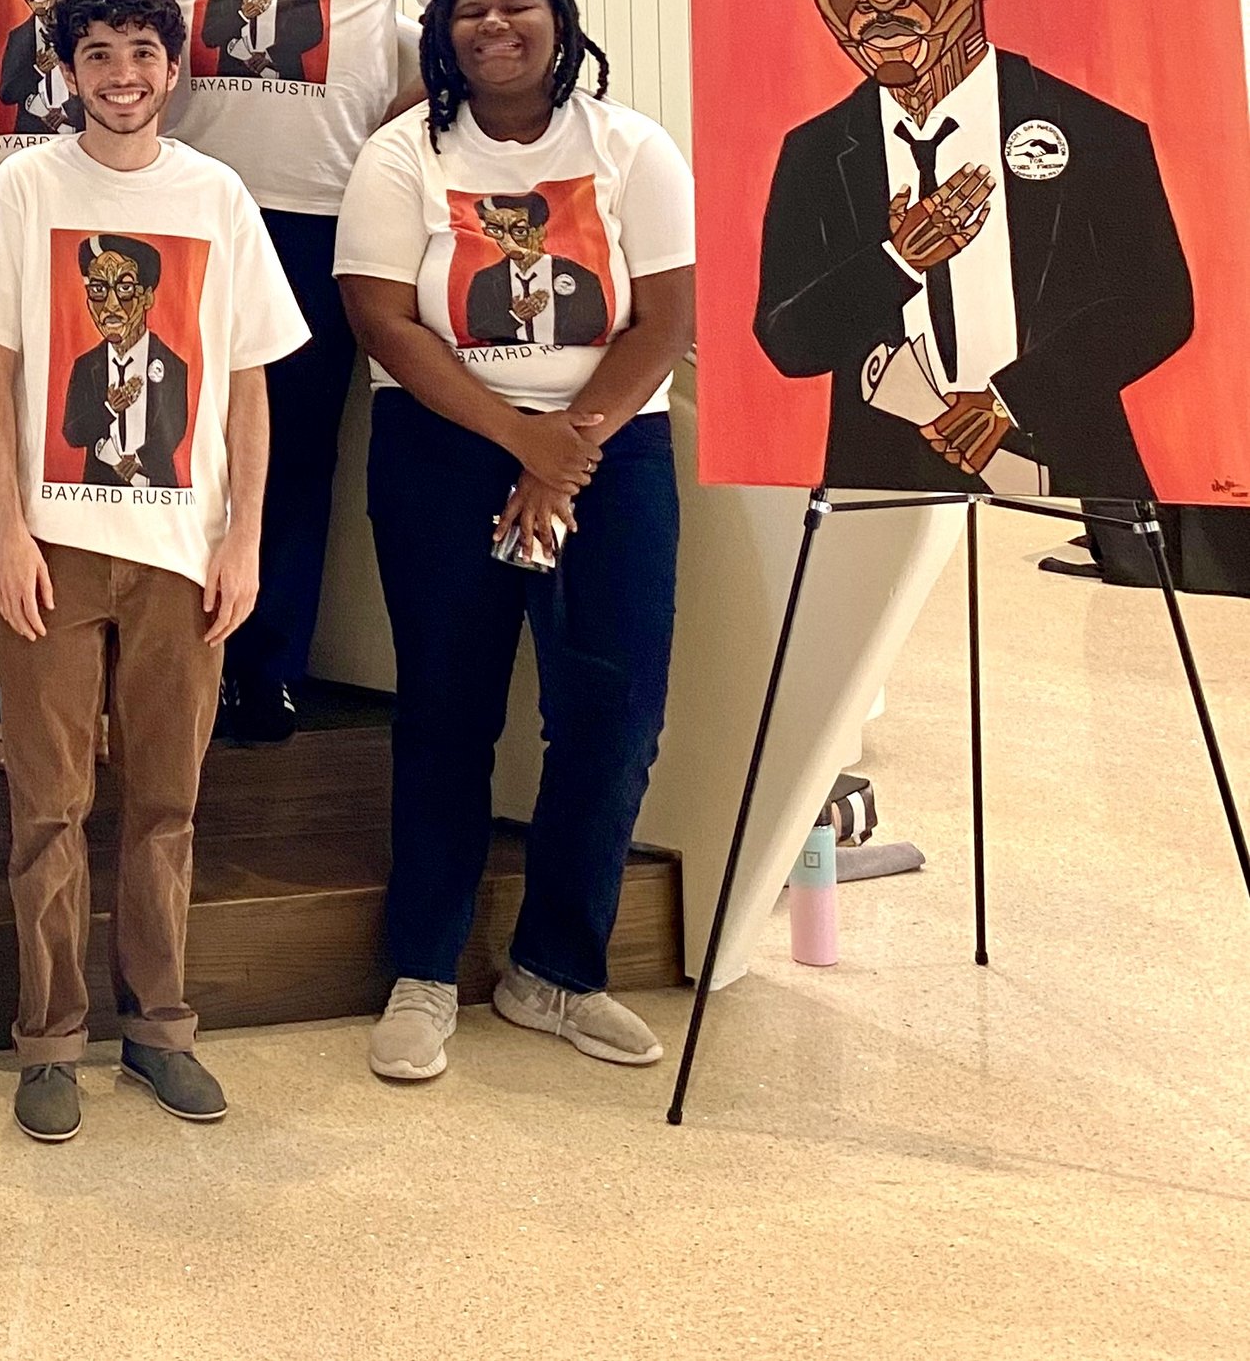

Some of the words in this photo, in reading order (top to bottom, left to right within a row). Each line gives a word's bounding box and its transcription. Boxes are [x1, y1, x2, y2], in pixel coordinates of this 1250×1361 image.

[191, 78, 253, 91] BAYARD
[261, 80, 327, 98] RUSTIN
[456, 345, 532, 363] BAYARD
[41, 484, 123, 504] BAYARD
[133, 489, 197, 505] RUSTIN
